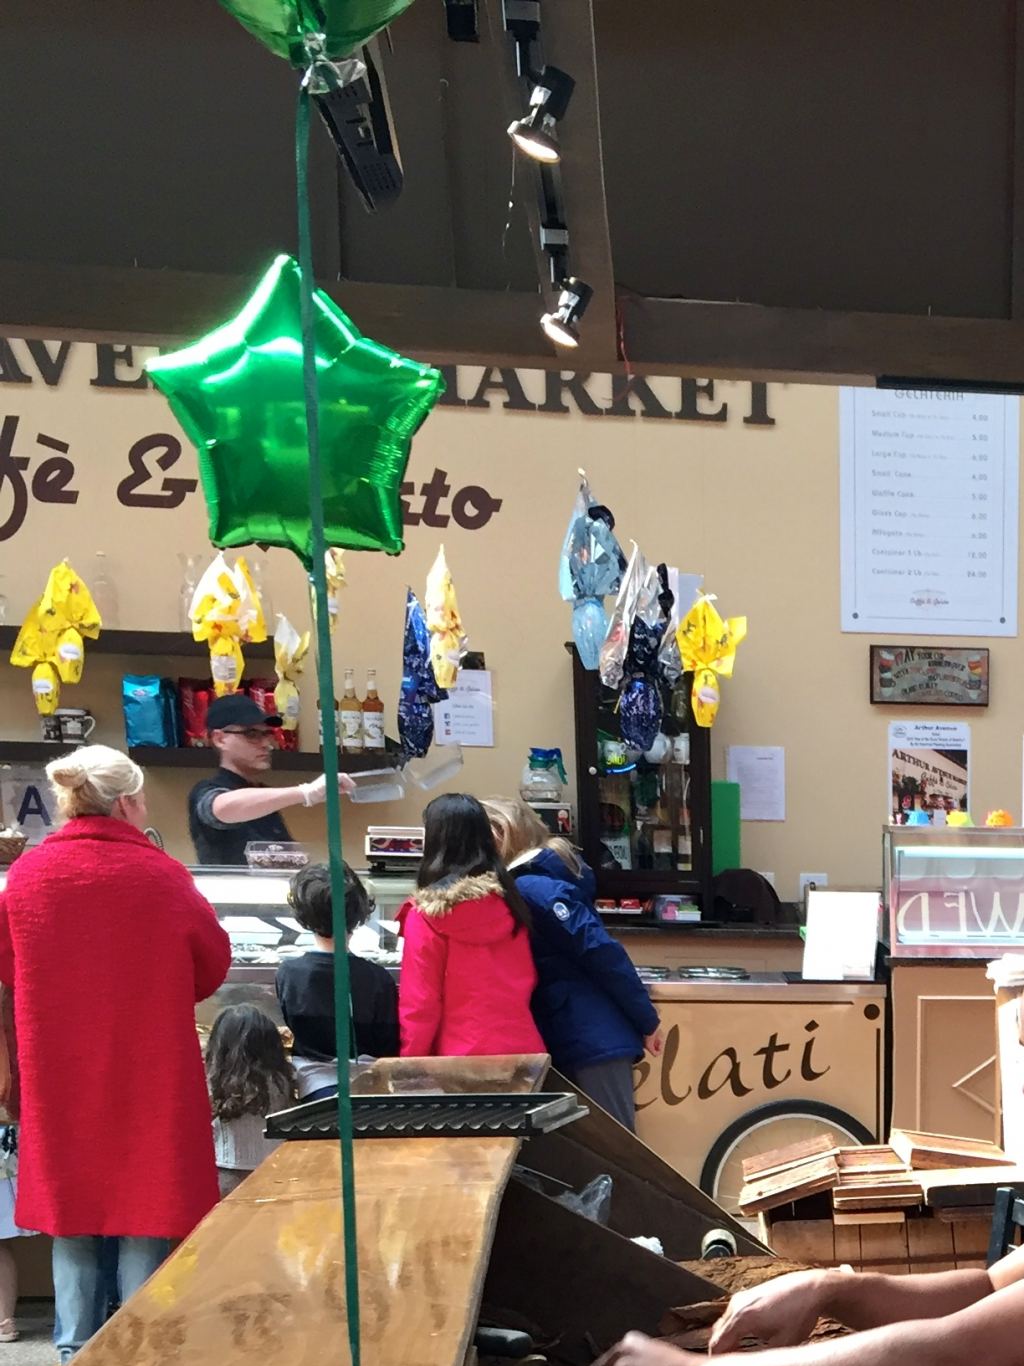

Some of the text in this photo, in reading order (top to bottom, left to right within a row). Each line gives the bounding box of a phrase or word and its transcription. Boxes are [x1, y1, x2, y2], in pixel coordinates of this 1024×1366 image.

[0, 337, 157, 389] AVE
[116, 433, 199, 509] &
[17, 785, 52, 826] A
[634, 1020, 831, 1111] elati
